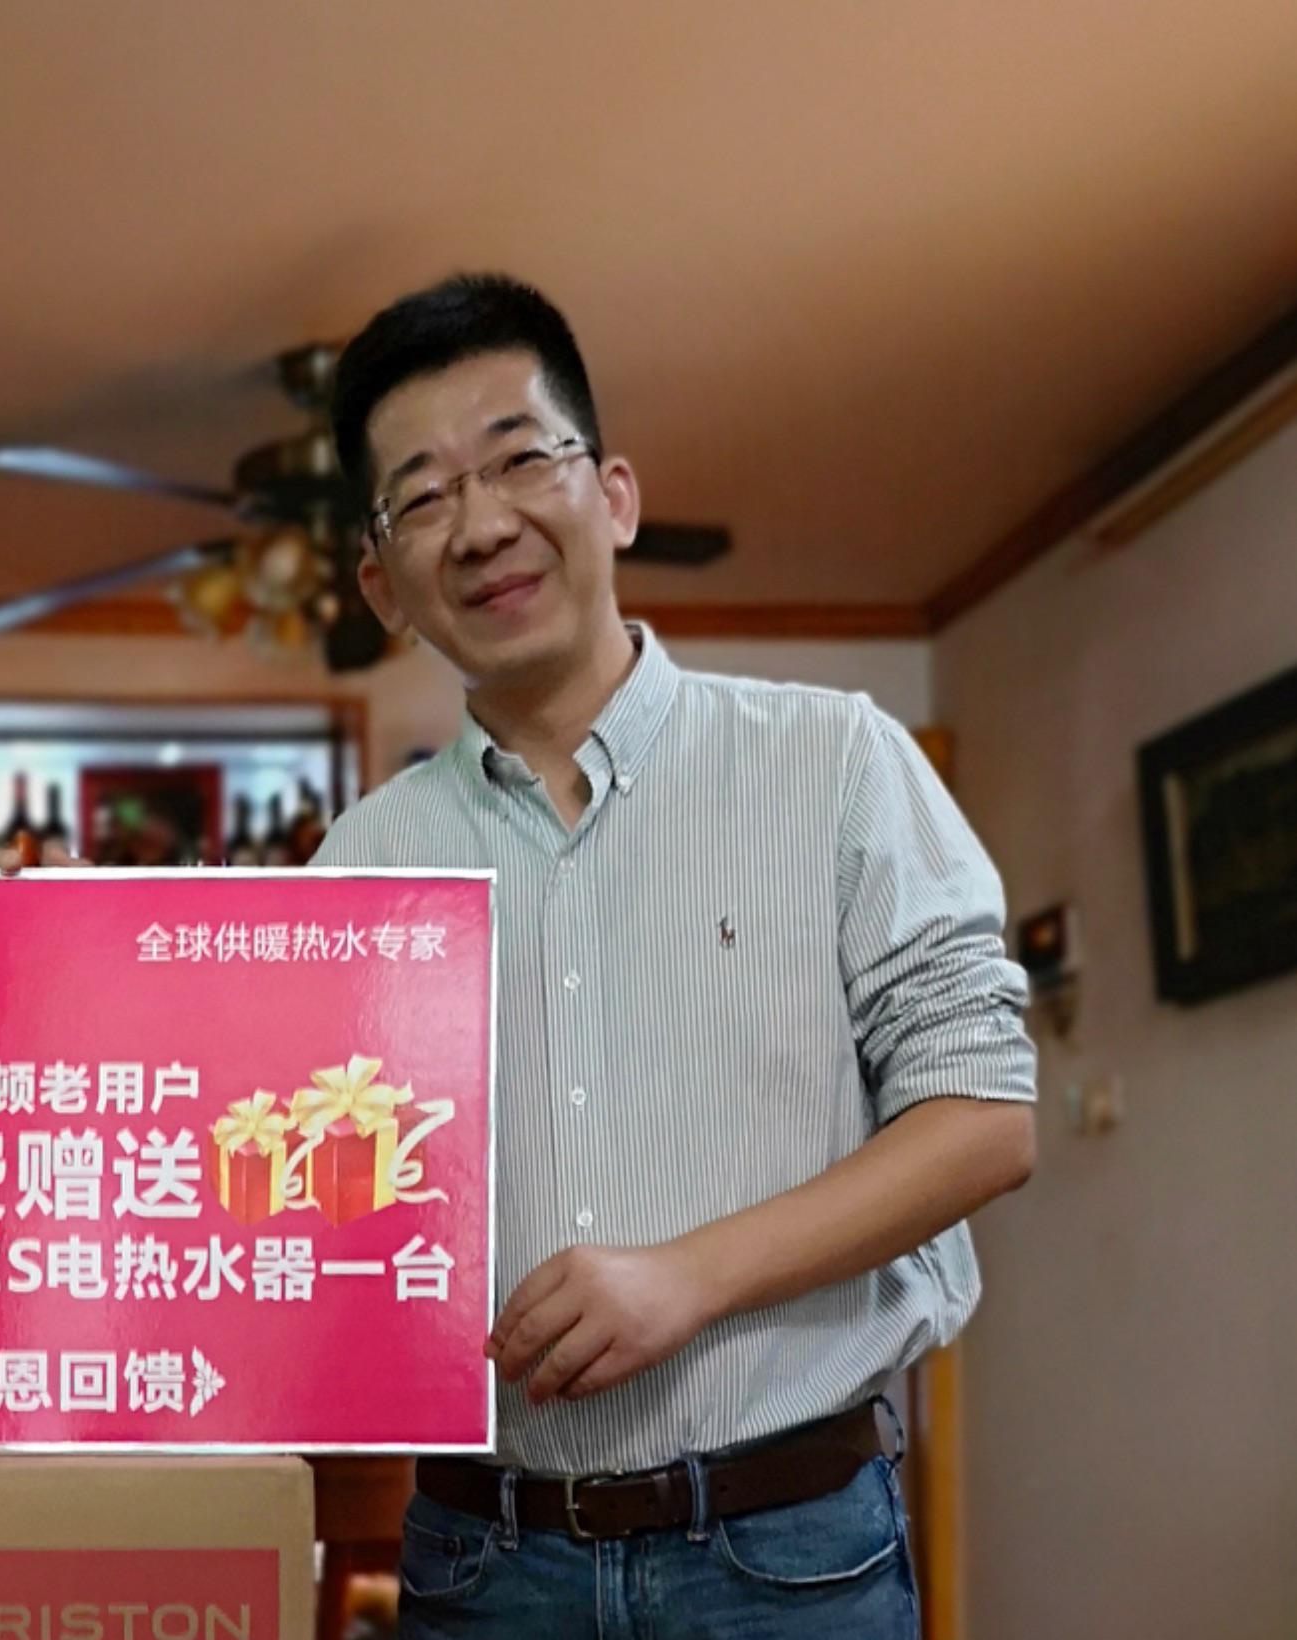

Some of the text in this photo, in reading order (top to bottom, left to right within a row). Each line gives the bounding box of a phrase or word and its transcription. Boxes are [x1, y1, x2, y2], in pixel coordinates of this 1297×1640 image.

[135, 920, 448, 963] 全球供暖热水专家
